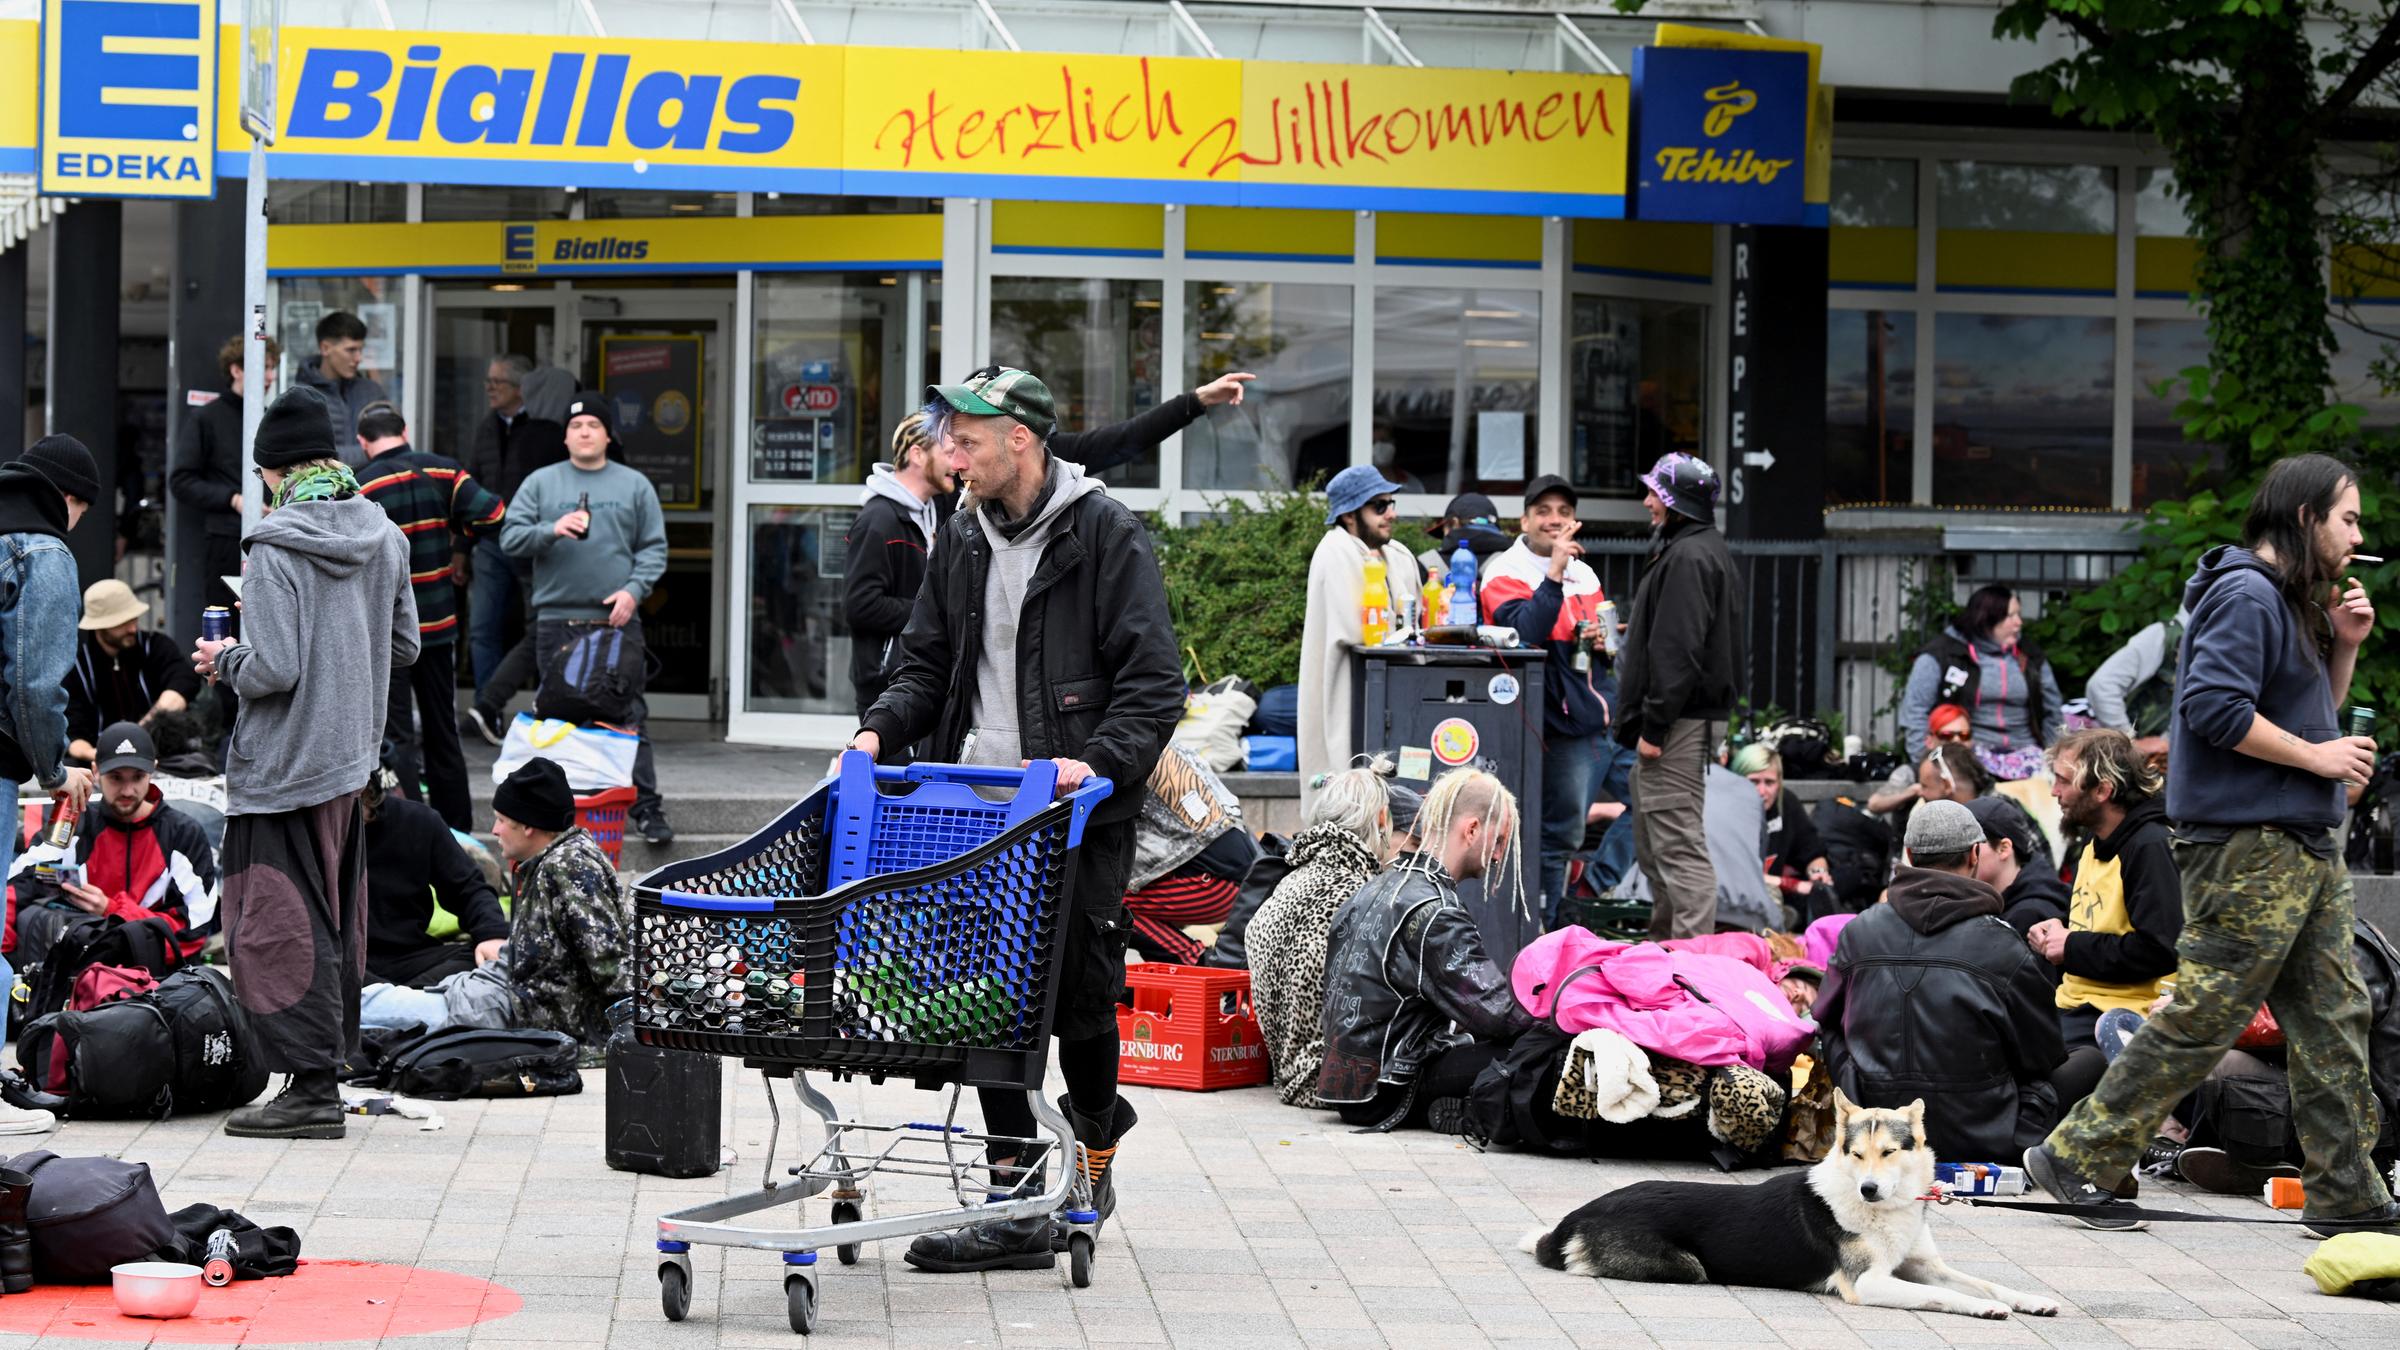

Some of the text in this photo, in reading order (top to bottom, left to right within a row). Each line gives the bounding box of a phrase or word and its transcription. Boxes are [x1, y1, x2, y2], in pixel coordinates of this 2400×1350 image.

[286, 45, 801, 154] Biallas
[874, 56, 1616, 178] Herzlich Willkommen
[57, 153, 202, 181] EDEKA
[1655, 147, 1794, 185] Tchibo
[554, 238, 649, 260] Biallas
[1731, 223, 1749, 504] RÊPES
[1120, 1040, 1183, 1062] ERNBURG
[1210, 1043, 1262, 1063] STERNBURG
